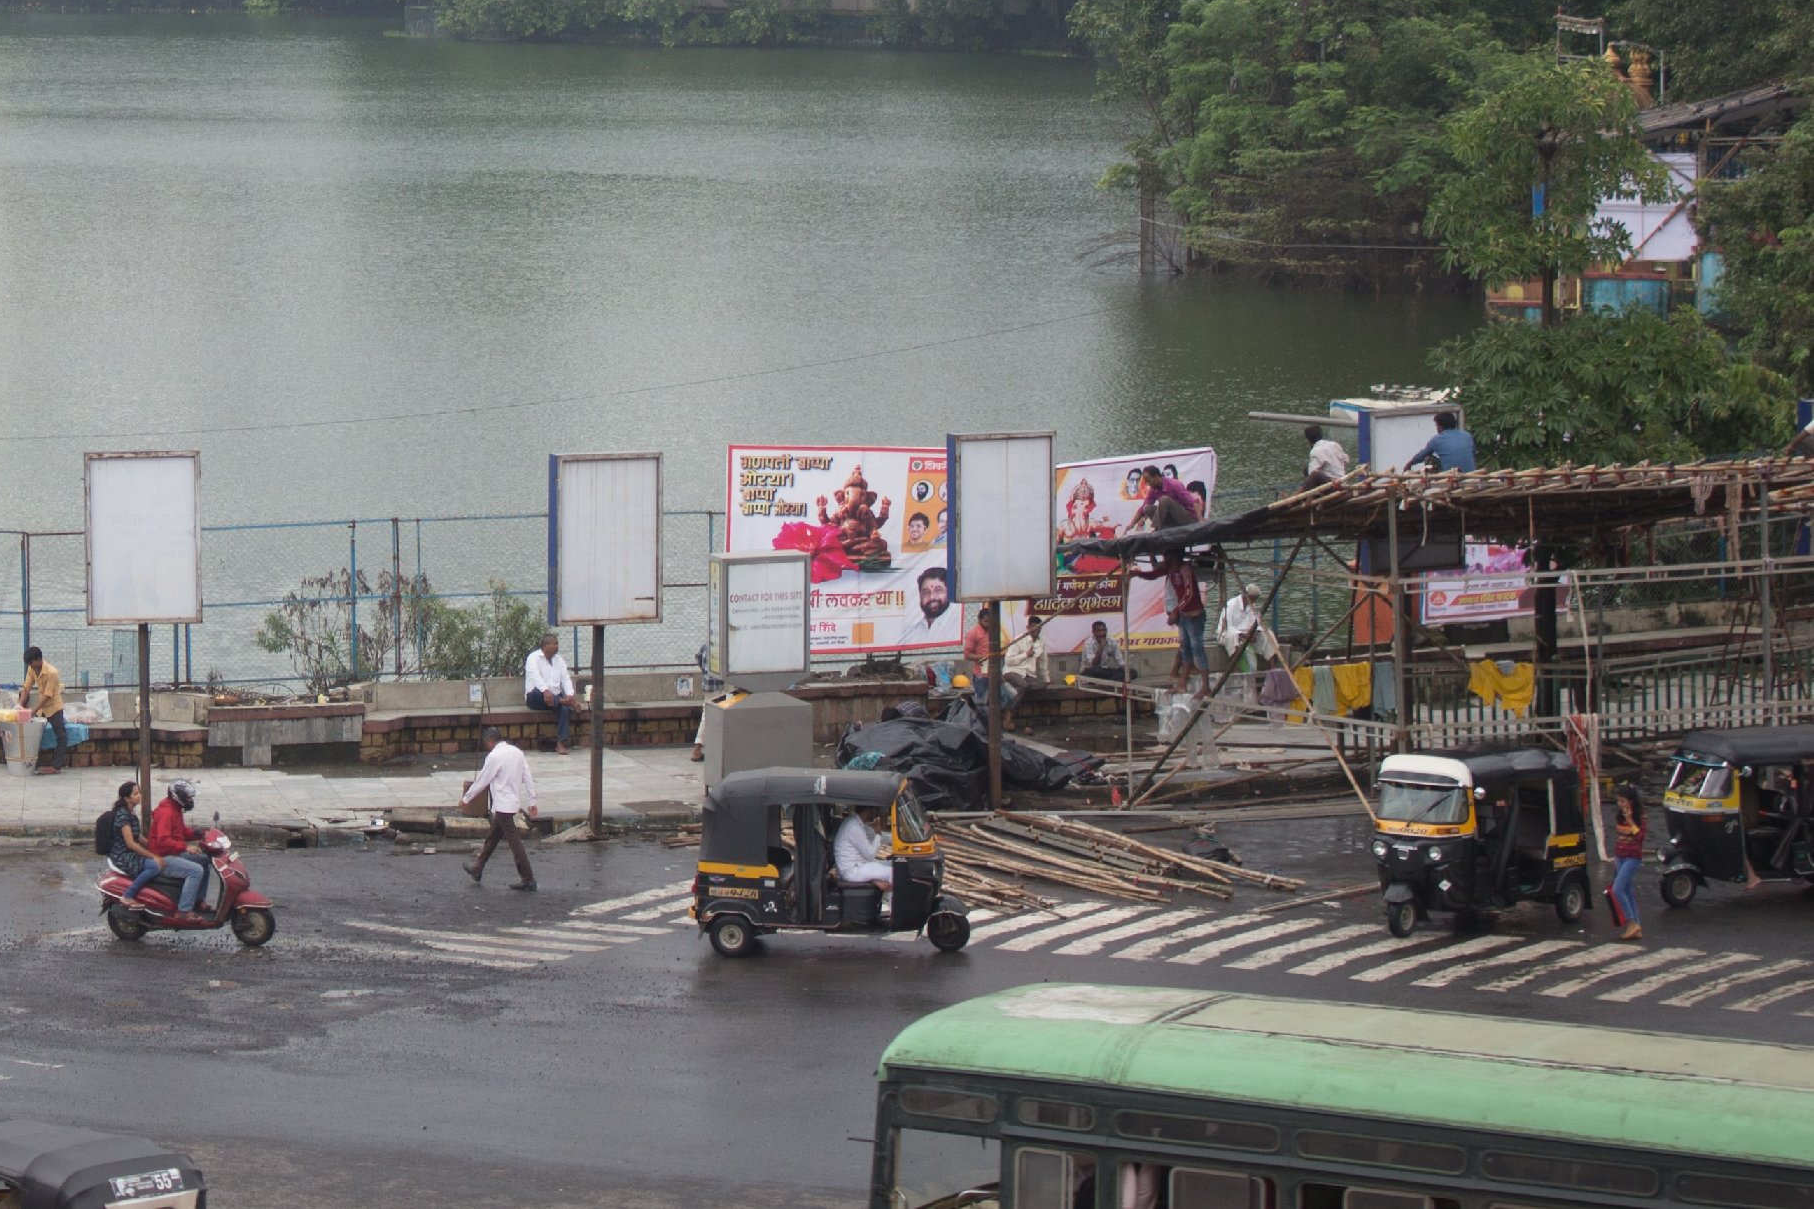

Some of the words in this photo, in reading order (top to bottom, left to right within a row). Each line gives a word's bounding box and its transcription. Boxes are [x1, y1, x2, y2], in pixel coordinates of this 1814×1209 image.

[740, 454, 793, 470] गणपती
[730, 593, 759, 603] CONTACT
[760, 593, 773, 601] FOR
[774, 592, 789, 600] THIS
[790, 591, 803, 600] SITE
[825, 593, 874, 609] लवकर
[1078, 593, 1122, 613] शुभेच्छा
[154, 1173, 172, 1190] 55
